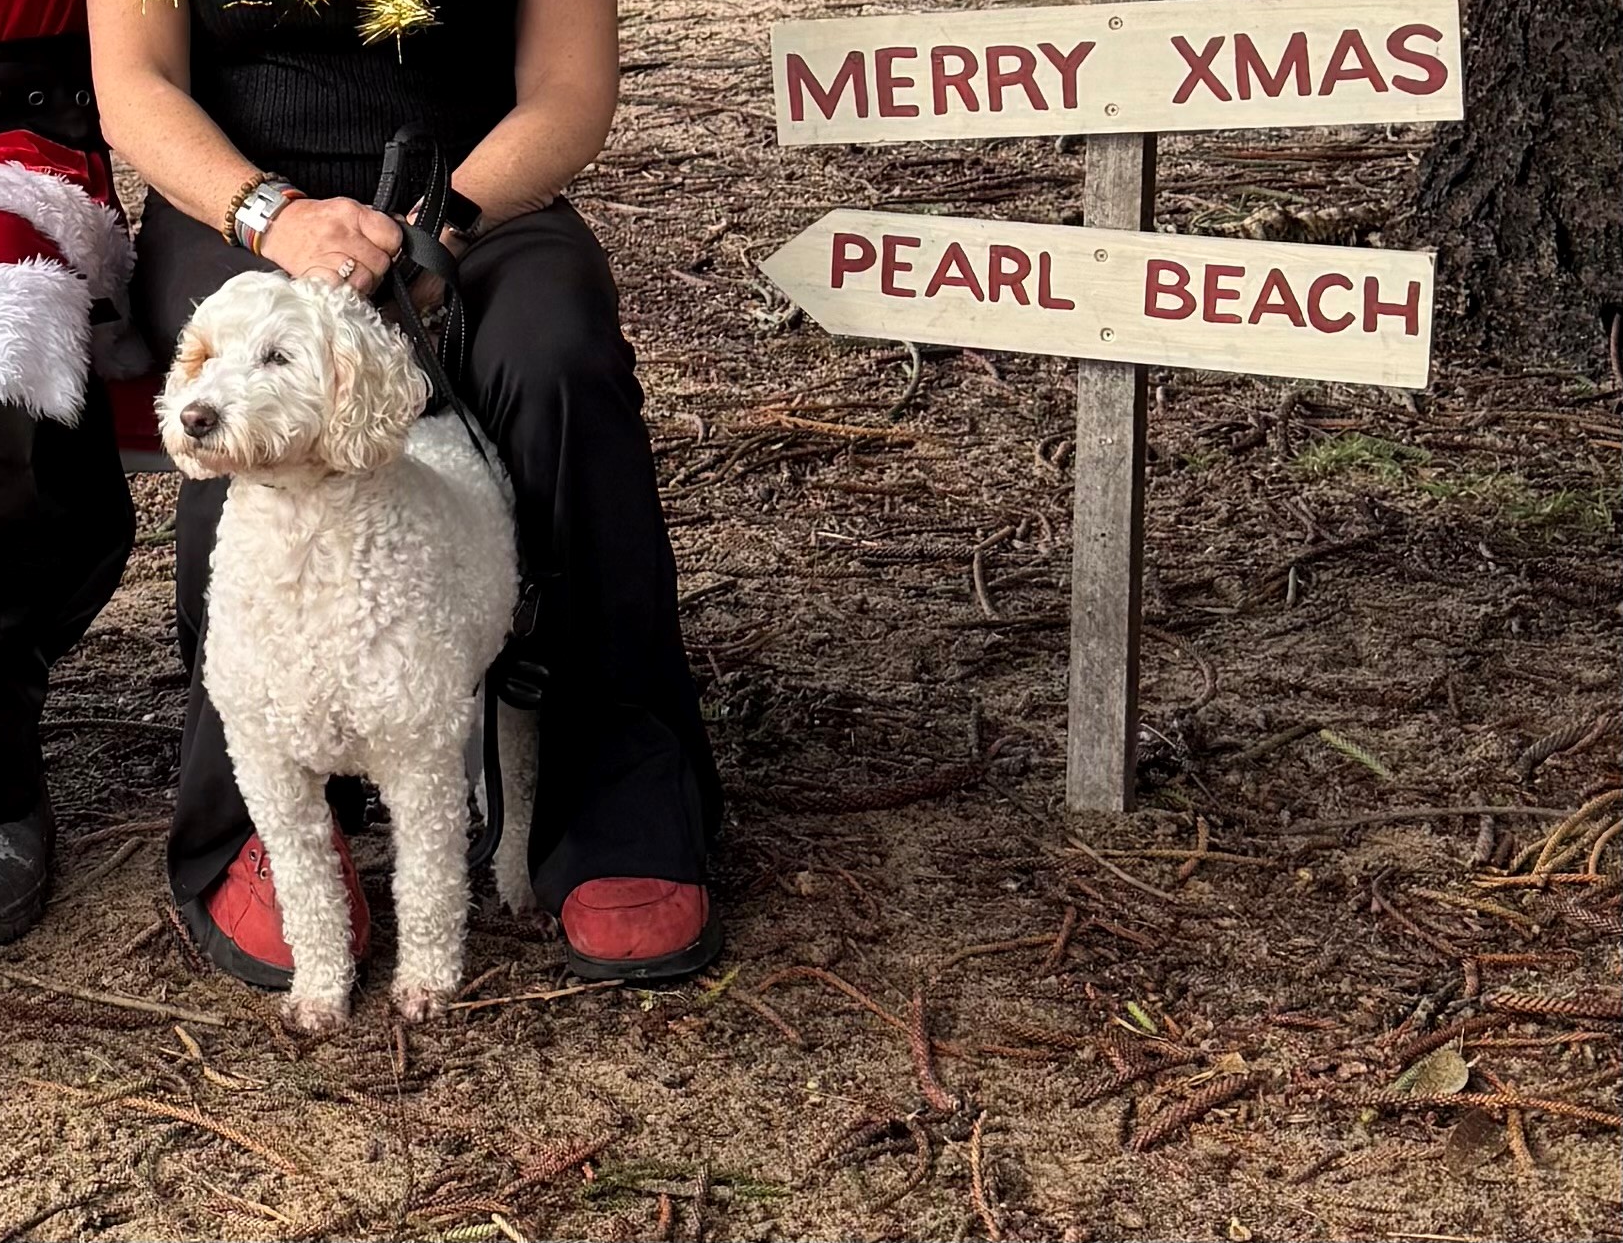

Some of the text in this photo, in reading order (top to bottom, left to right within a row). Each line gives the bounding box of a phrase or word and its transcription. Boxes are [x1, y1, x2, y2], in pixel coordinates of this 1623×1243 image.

[787, 24, 1448, 122] MERRY XMAS
[830, 233, 1420, 336] PEARL BEACH
